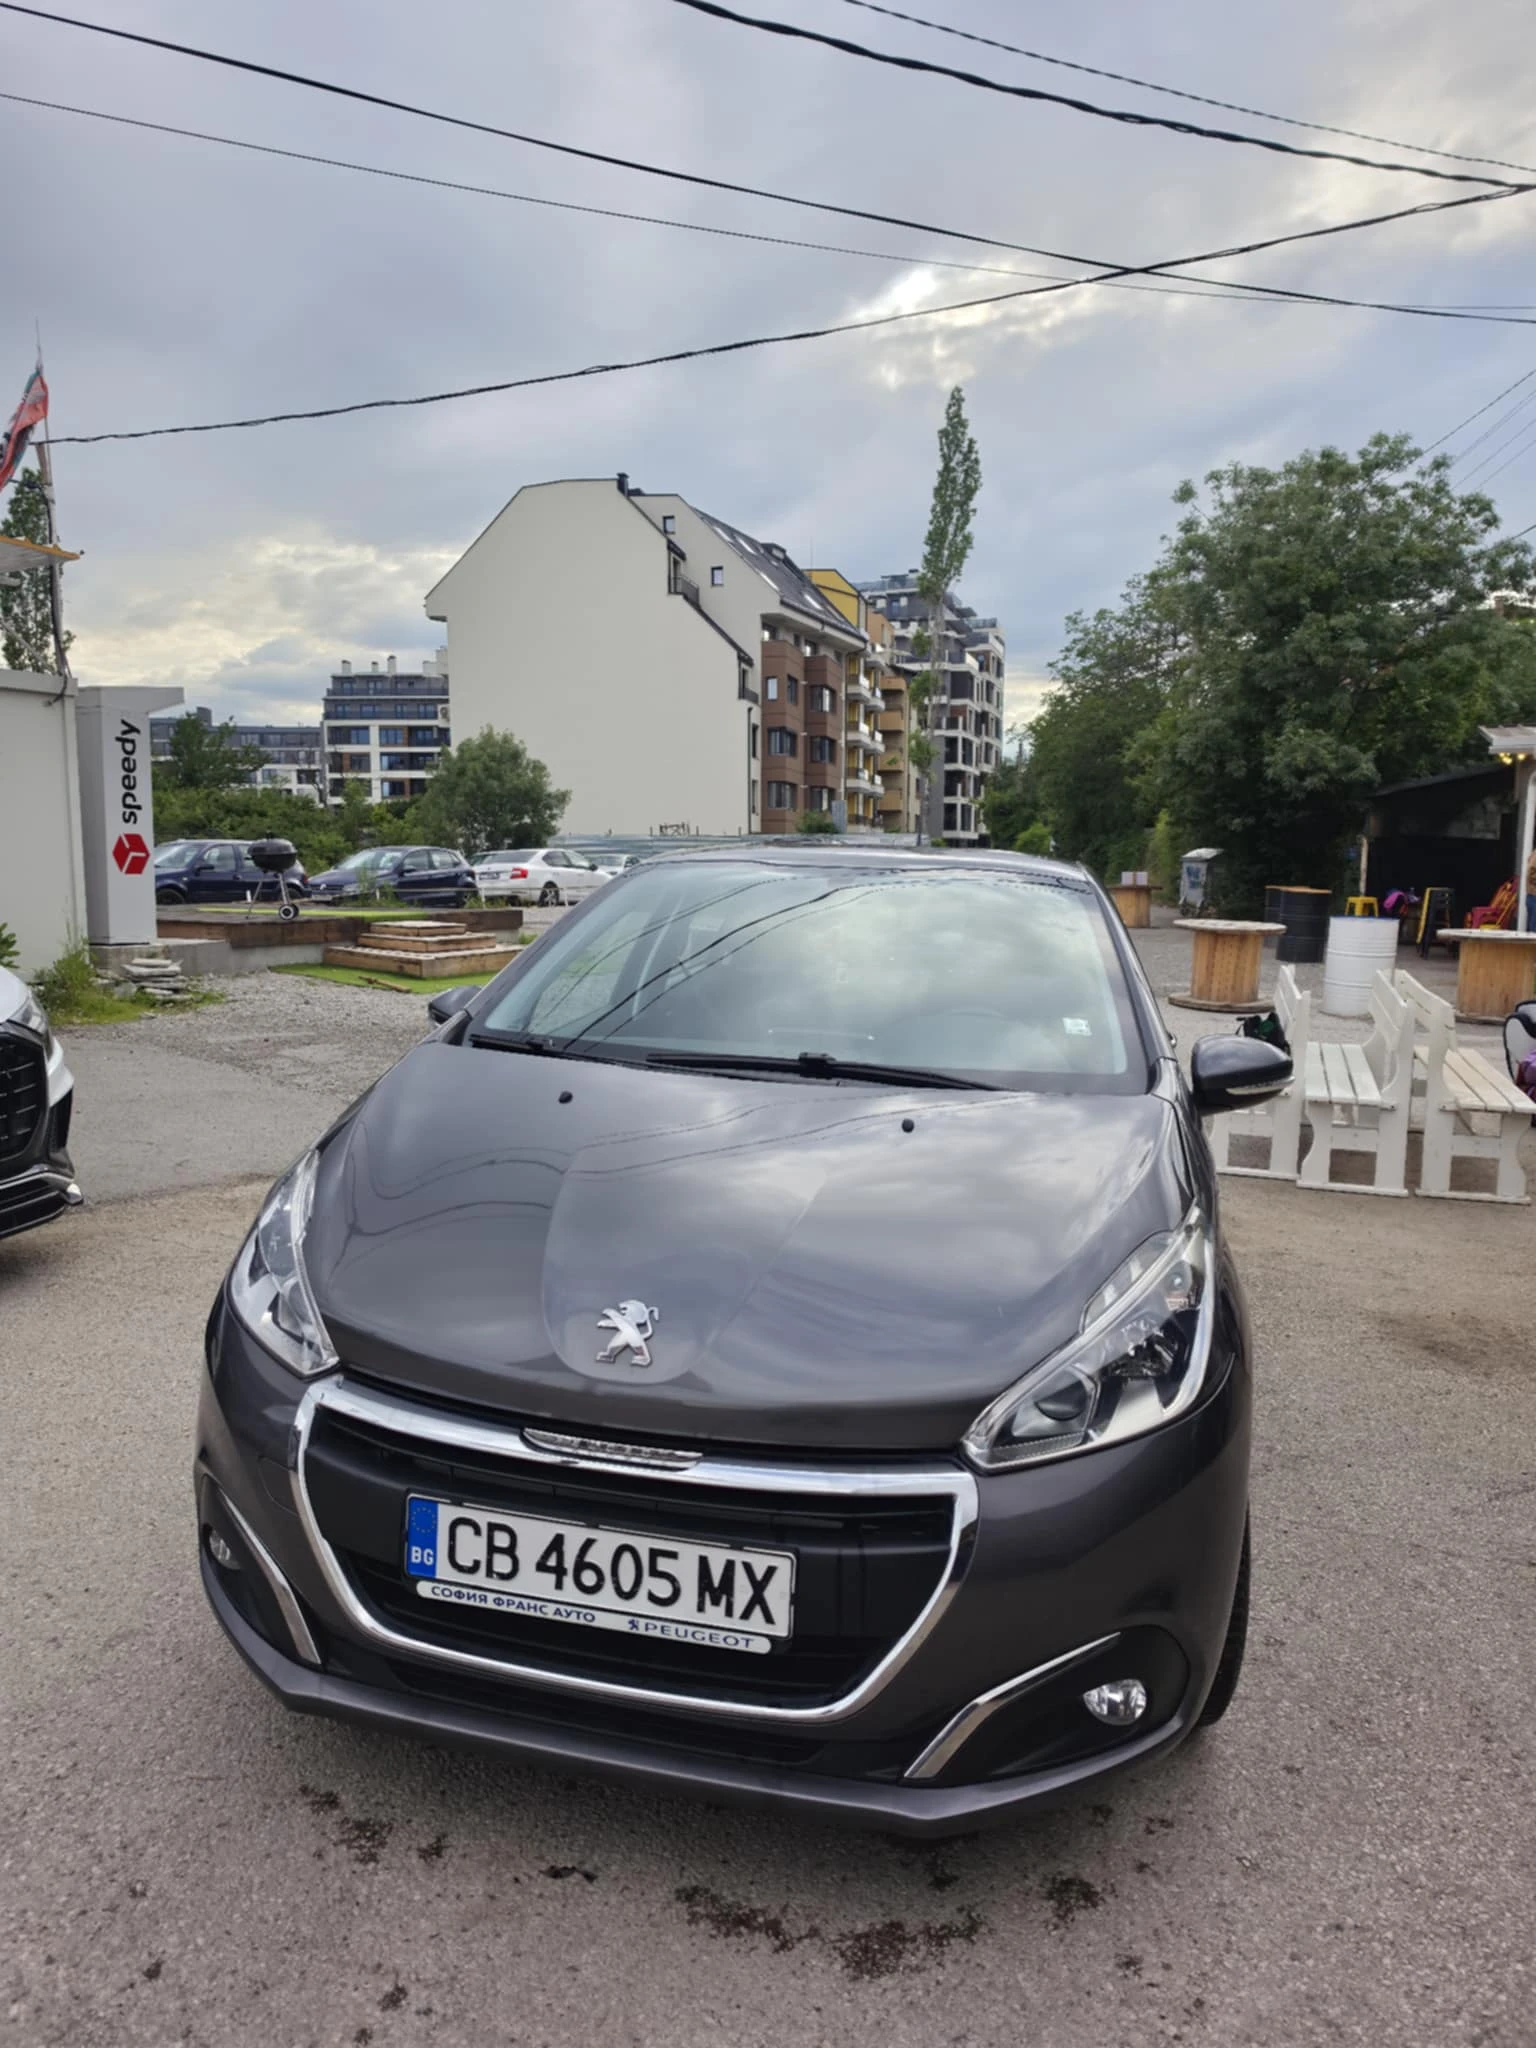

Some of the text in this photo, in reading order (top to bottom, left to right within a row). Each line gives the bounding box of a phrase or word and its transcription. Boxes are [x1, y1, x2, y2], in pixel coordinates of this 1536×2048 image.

[115, 719, 142, 824] speedy
[411, 1546, 434, 1566] BG
[447, 1516, 779, 1625] CB 4605 MX
[431, 1585, 596, 1624] СОФИЯ ФРАНС АУТО
[644, 1622, 755, 1649] PEUGEOT
